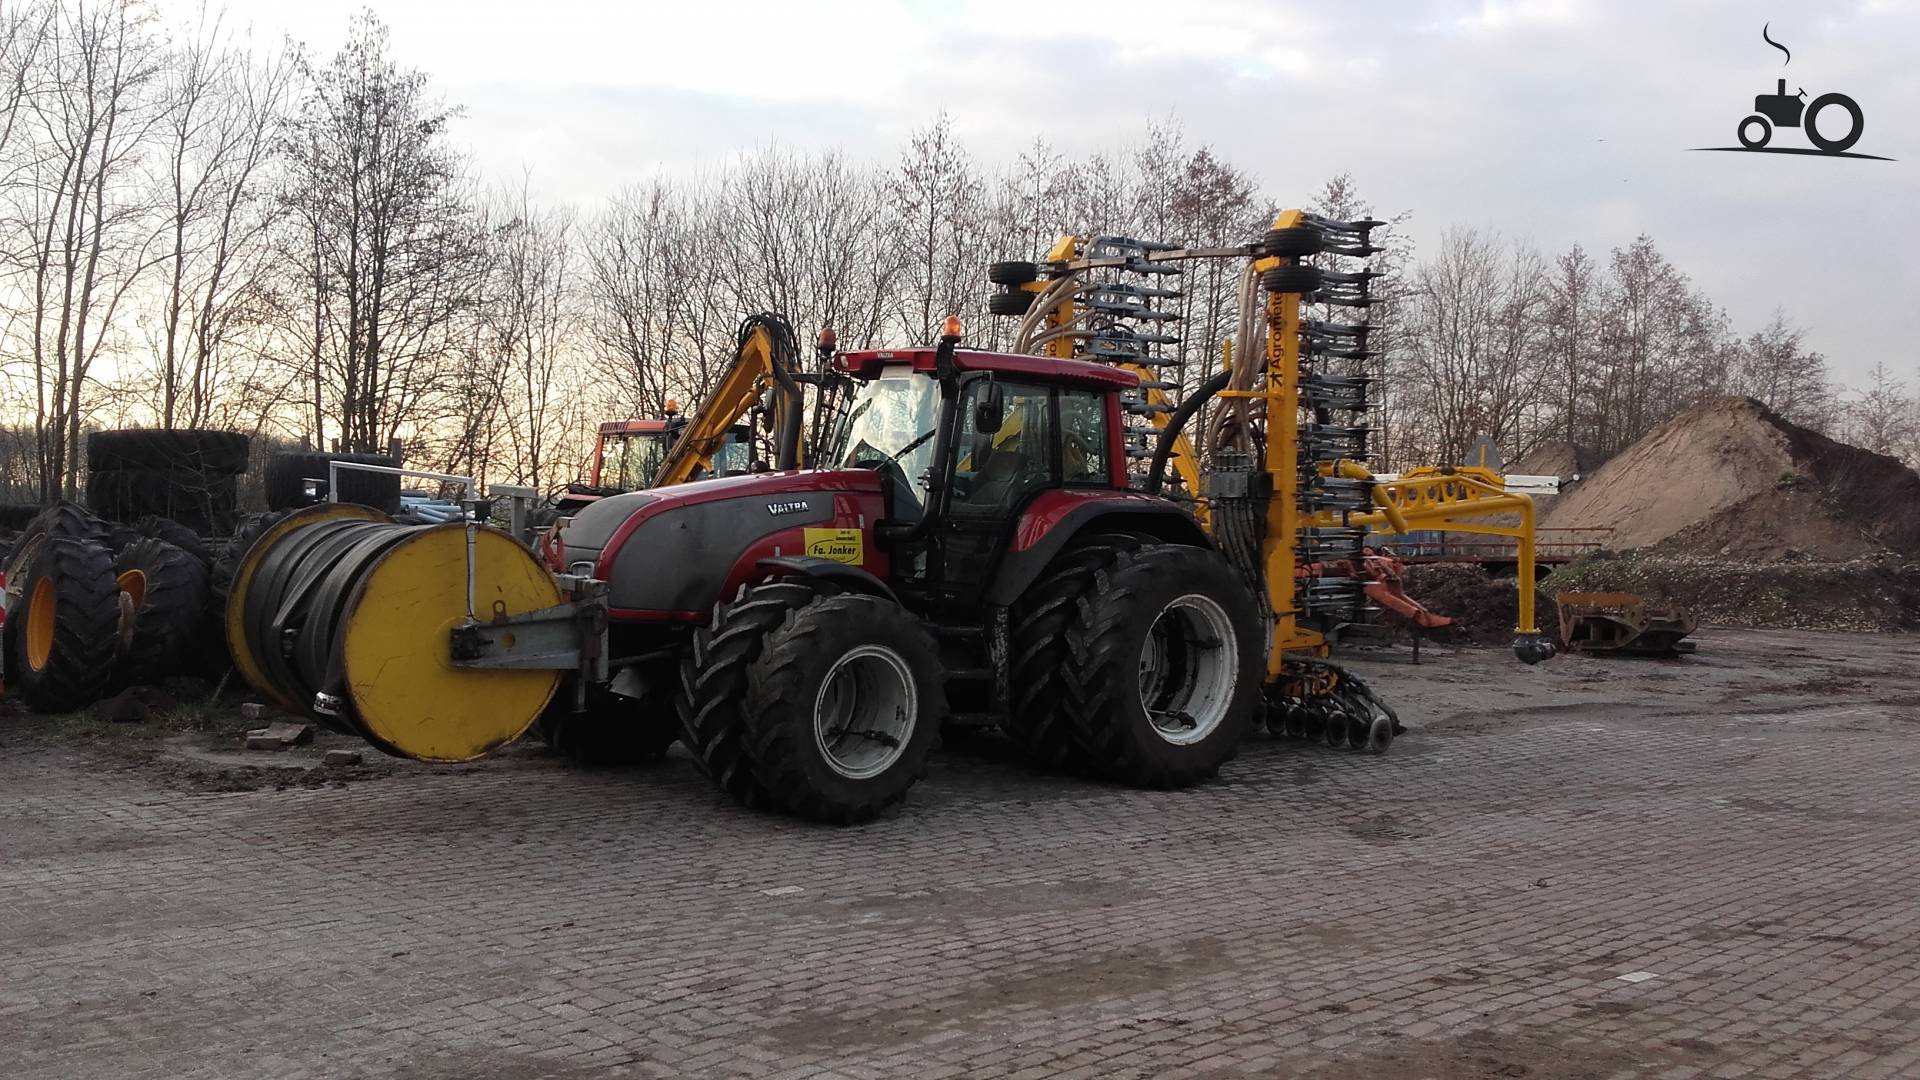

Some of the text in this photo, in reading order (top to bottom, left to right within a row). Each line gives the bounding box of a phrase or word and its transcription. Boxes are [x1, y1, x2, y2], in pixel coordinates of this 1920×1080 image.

[767, 501, 809, 515] VALTRA
[814, 545, 857, 555] Fa. Jonker
